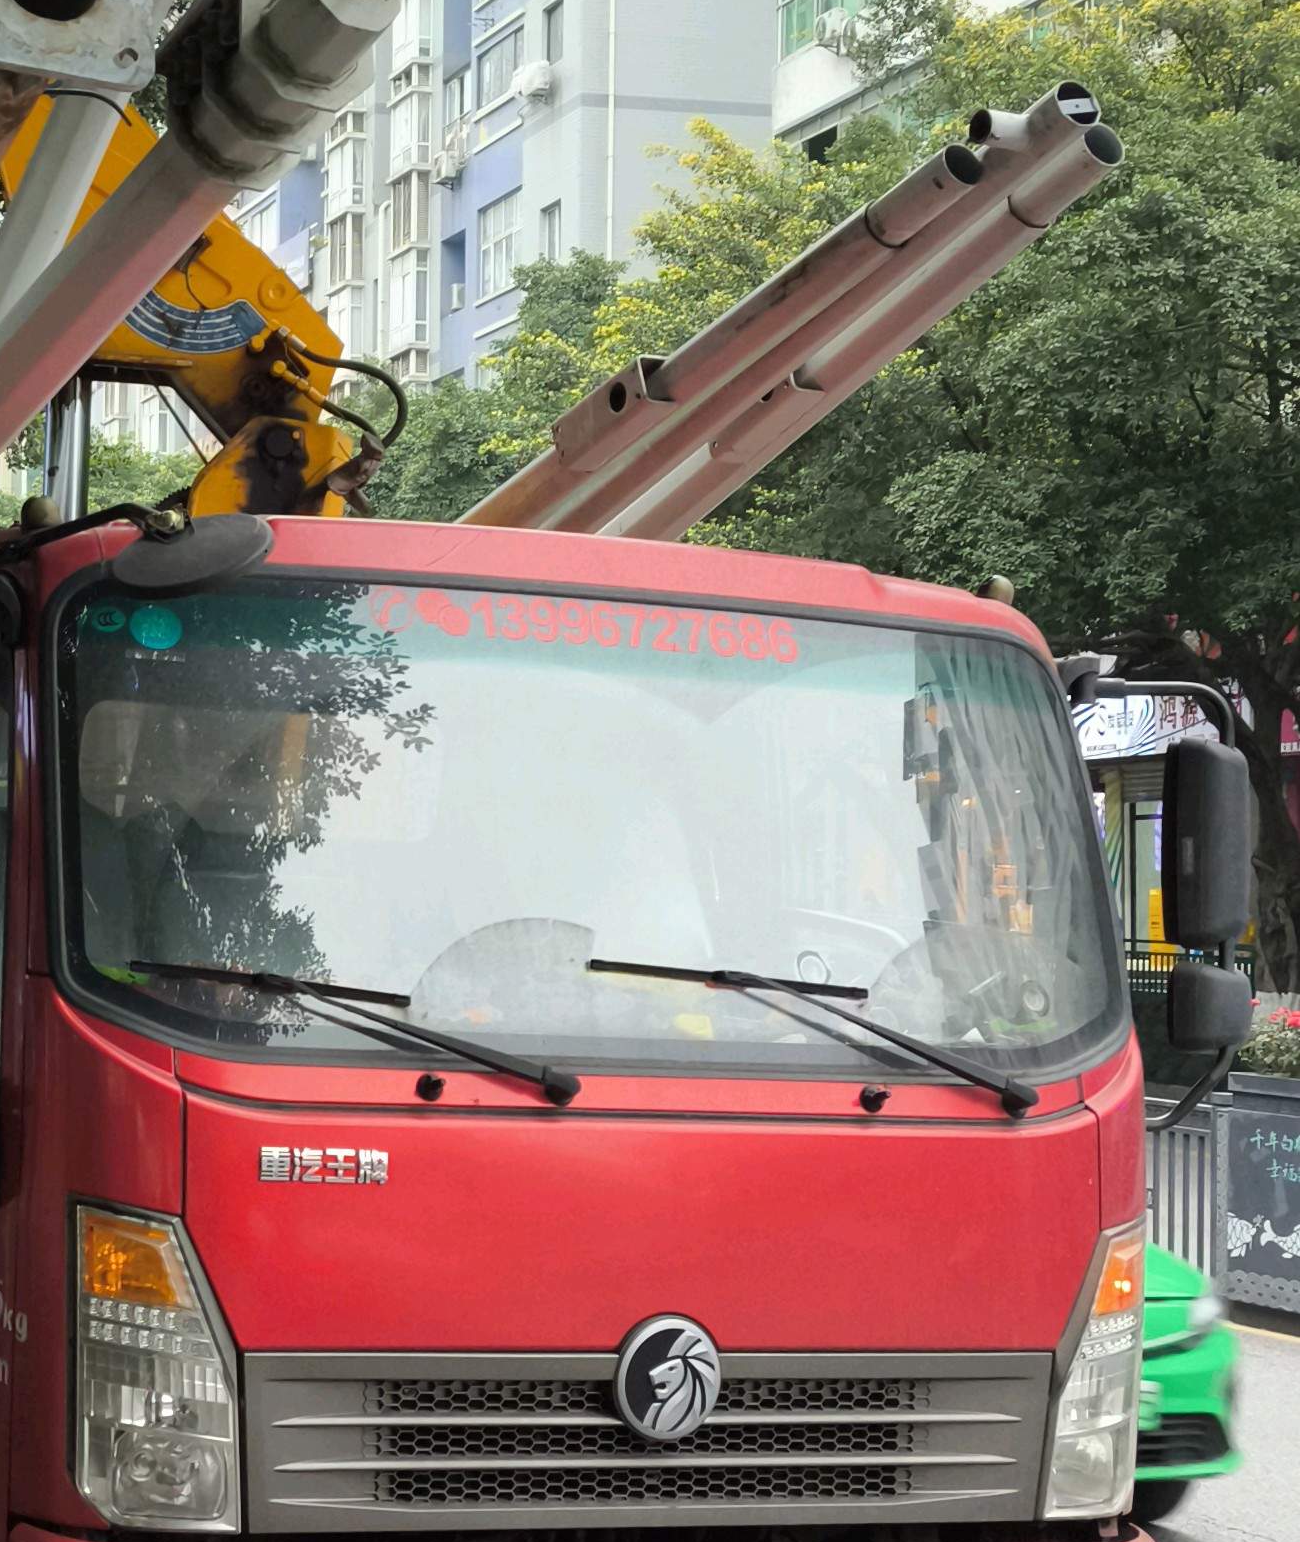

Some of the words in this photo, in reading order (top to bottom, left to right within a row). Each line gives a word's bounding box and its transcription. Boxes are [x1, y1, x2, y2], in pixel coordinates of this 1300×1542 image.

[471, 593, 798, 663] 13996727686
[260, 1146, 389, 1186] 重汽王牌
[1266, 1158, 1300, 1182] 幸福
